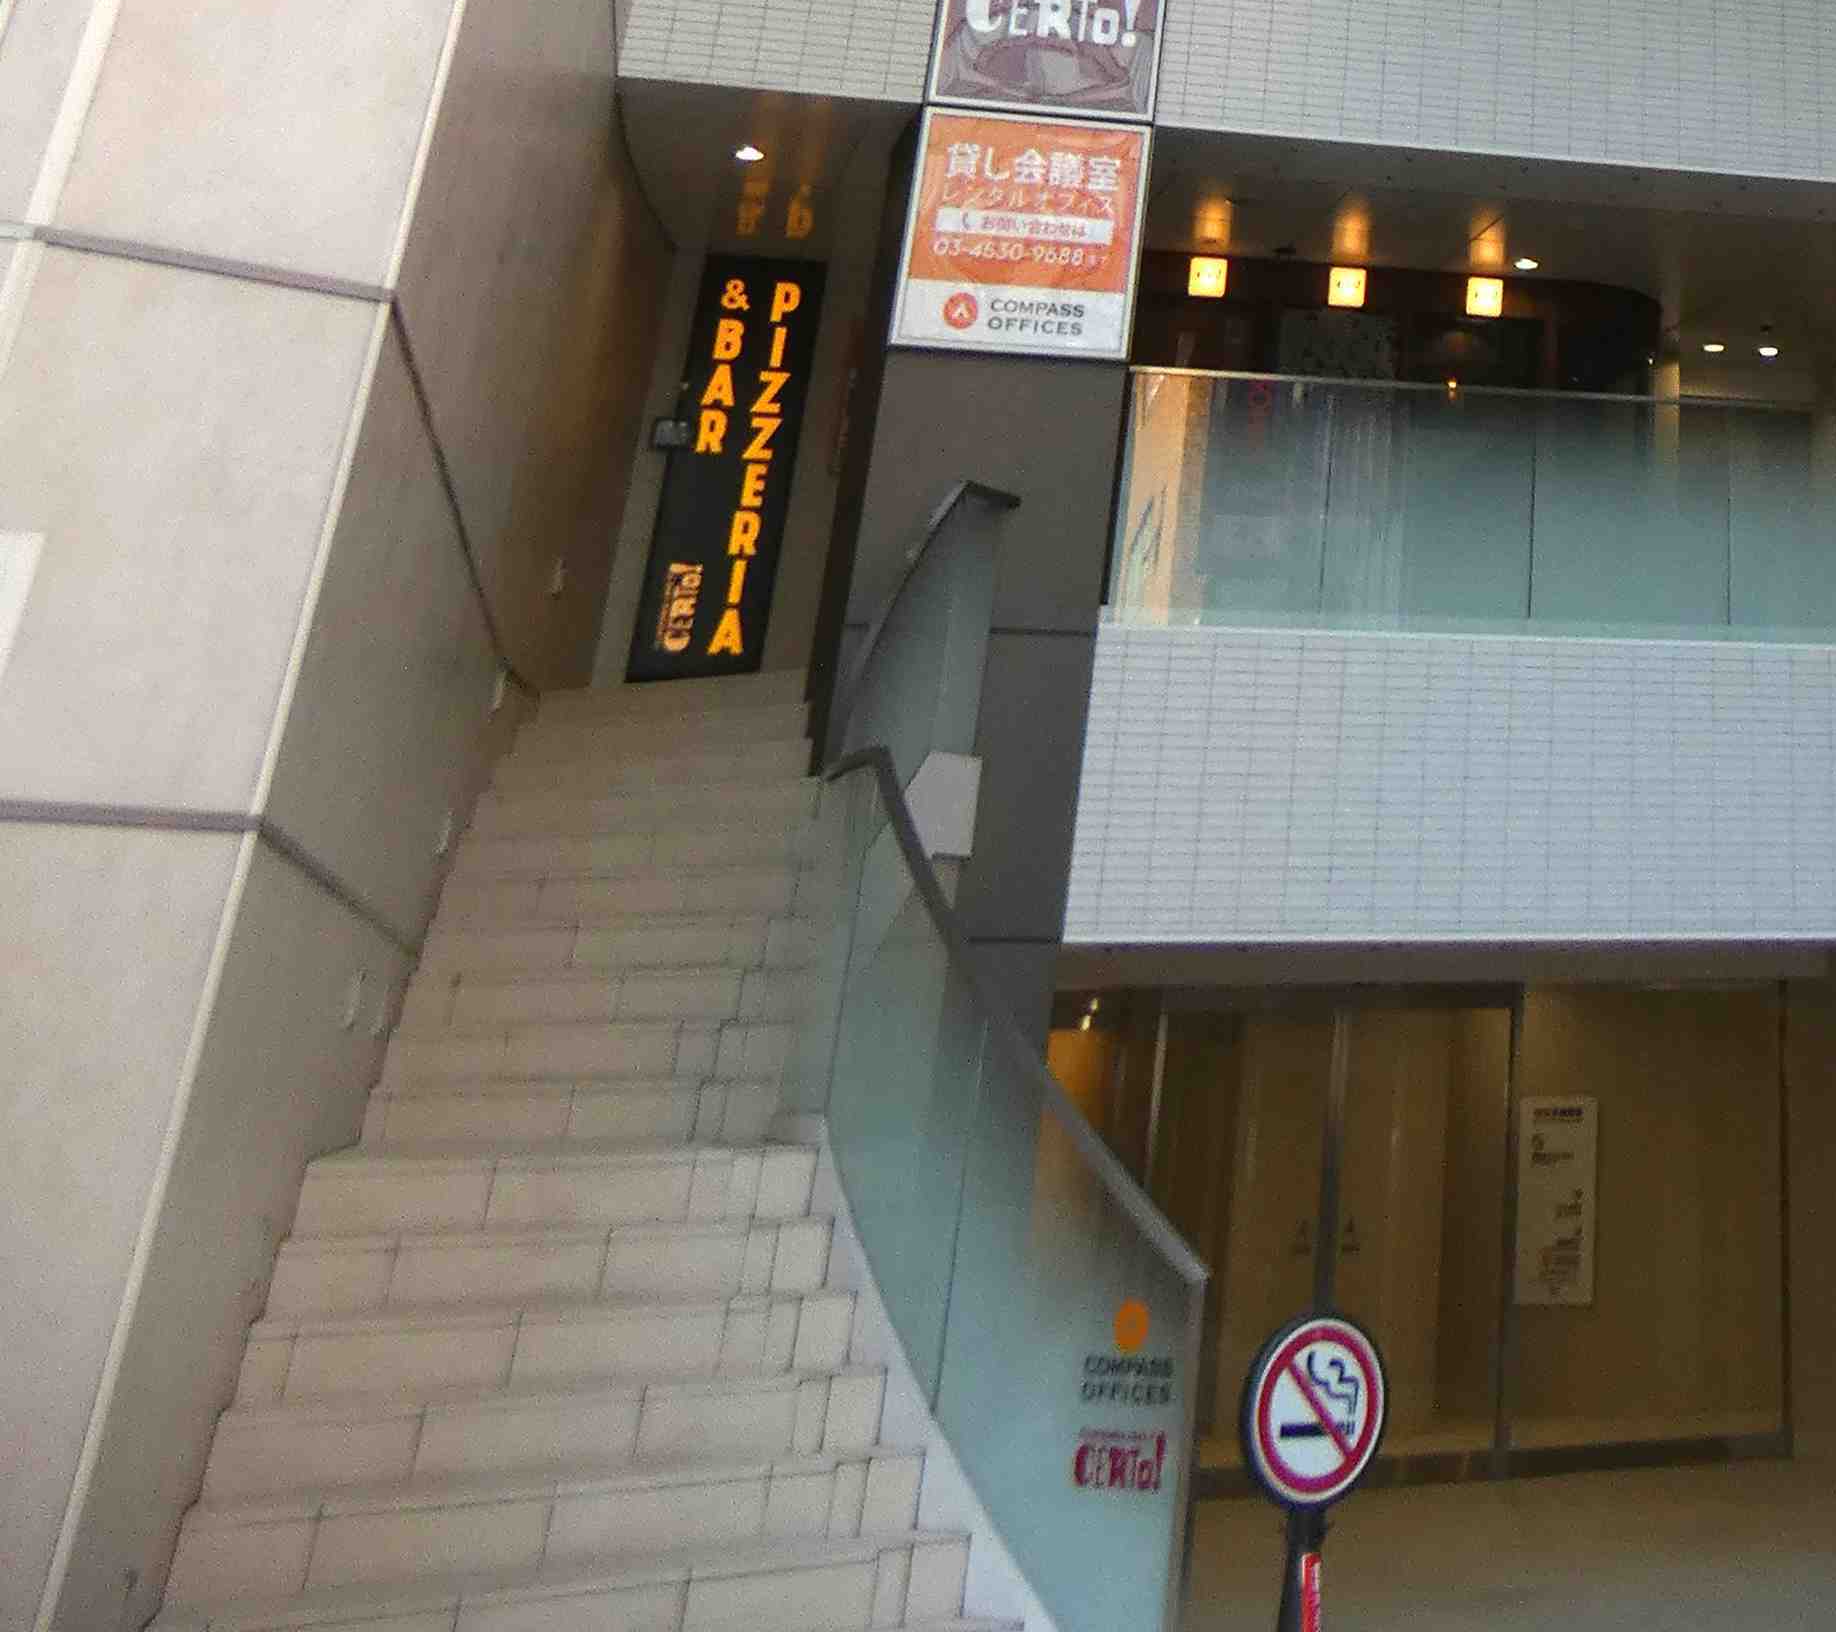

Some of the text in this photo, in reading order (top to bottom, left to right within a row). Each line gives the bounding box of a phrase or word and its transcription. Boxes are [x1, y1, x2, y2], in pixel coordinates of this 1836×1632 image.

[946, 143, 1121, 192] 貸し会議室
[986, 316, 1084, 337] OFFICES
[989, 298, 1086, 319] COMPASS
[695, 278, 751, 455] & BAR
[706, 280, 801, 656] PIZZERIA
[1079, 1380, 1173, 1406] OFFICES
